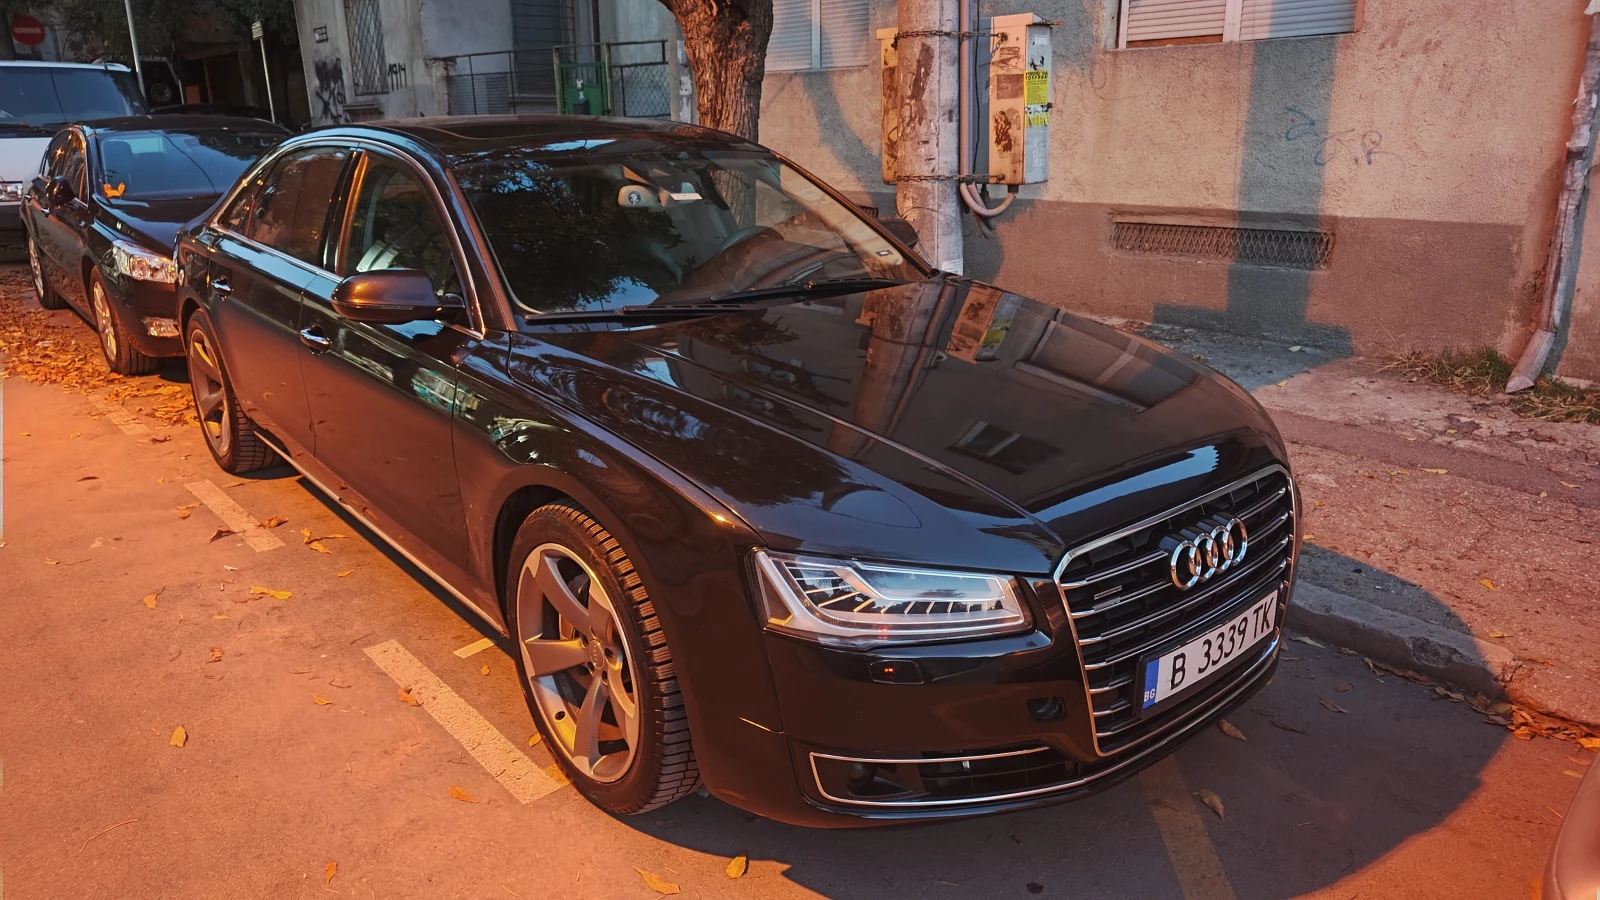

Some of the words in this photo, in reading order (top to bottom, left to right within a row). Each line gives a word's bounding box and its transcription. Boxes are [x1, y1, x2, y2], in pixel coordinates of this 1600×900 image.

[1170, 653, 1186, 690] B
[1198, 617, 1248, 673] 3339
[1253, 597, 1274, 639] TK
[1144, 688, 1155, 702] BG
